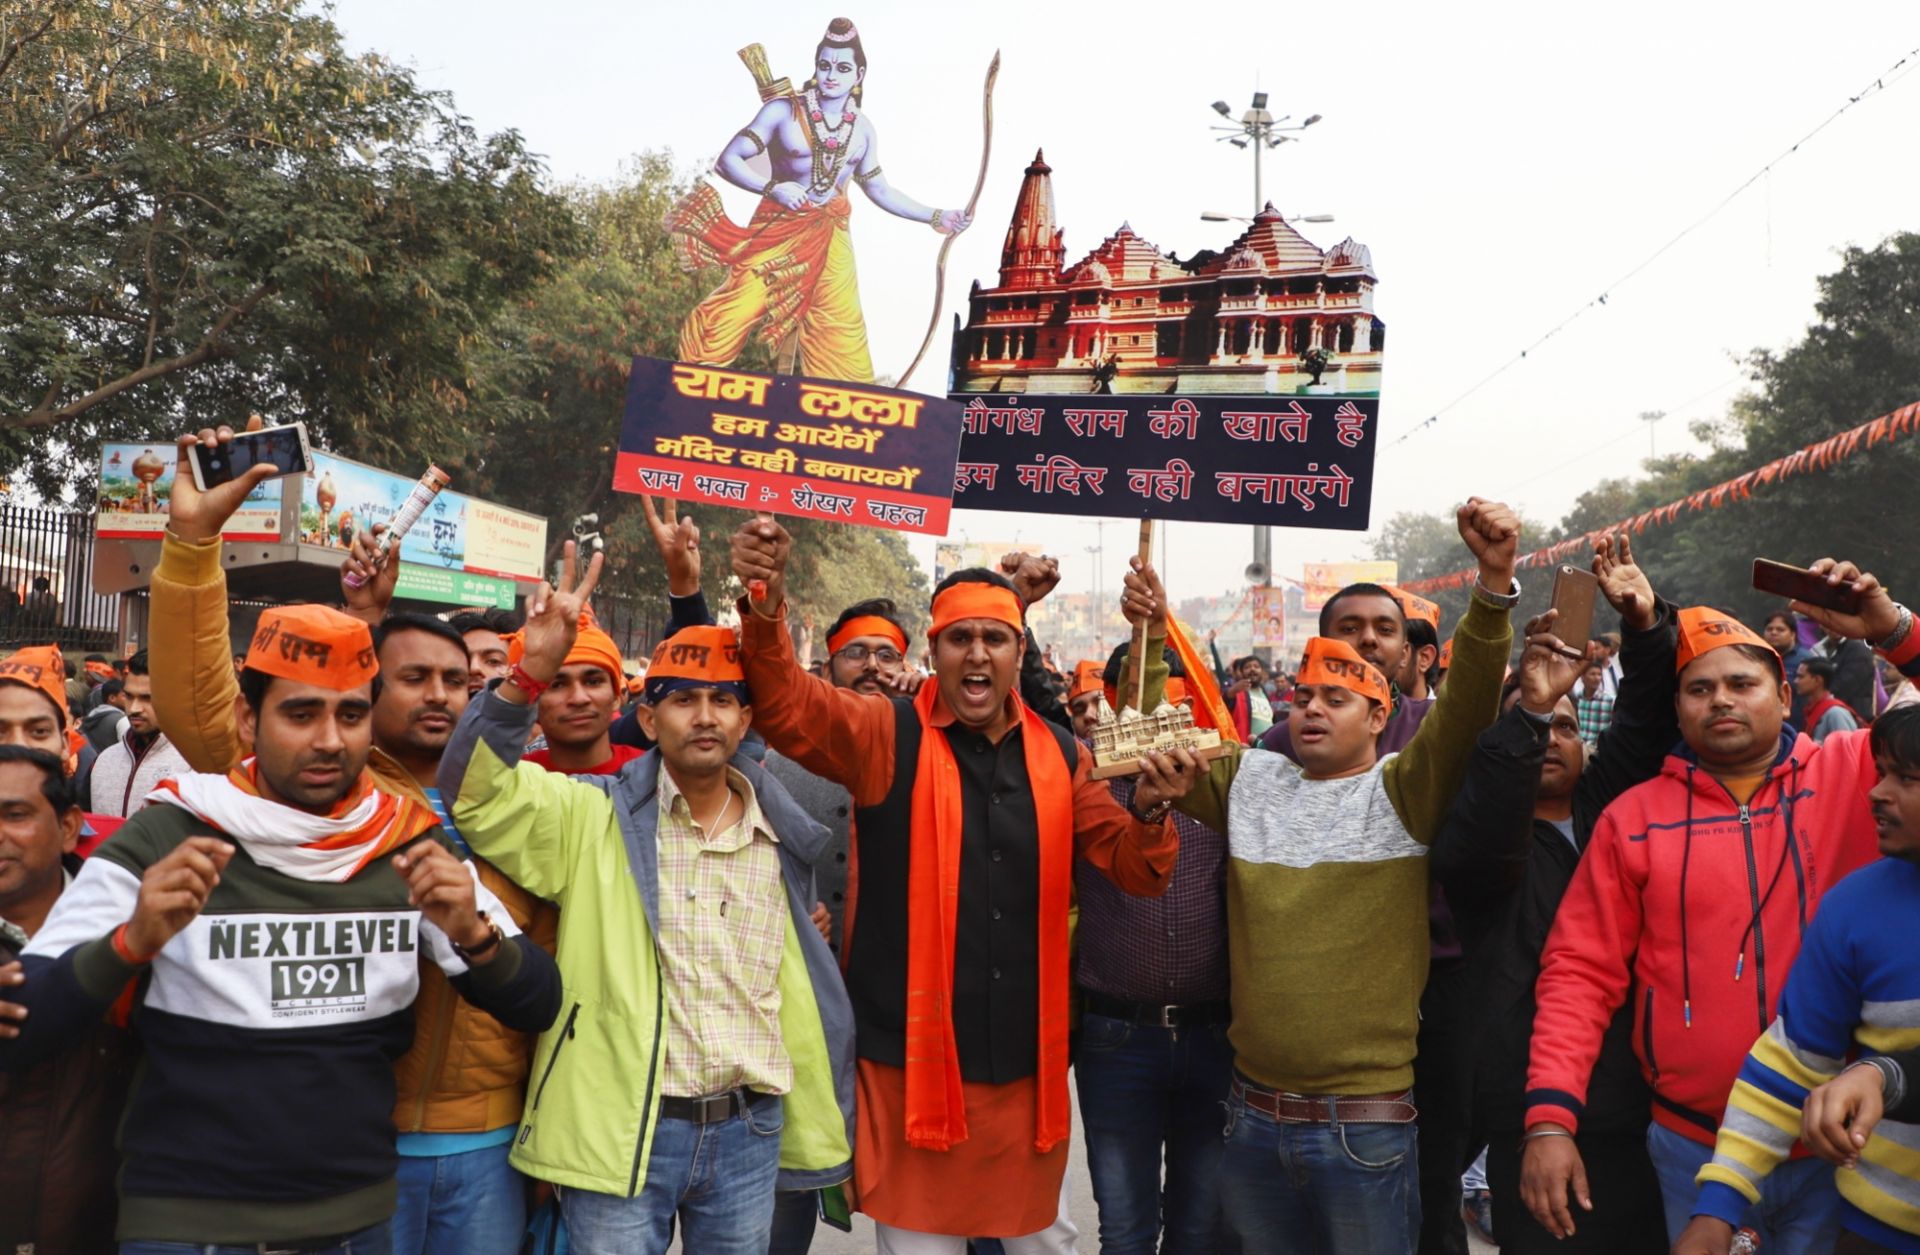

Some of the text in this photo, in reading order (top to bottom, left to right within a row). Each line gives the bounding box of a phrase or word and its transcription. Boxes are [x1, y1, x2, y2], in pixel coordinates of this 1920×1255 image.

[672, 364, 924, 428] राम लला
[712, 412, 769, 438] हम
[1063, 408, 1128, 438] राम
[1148, 401, 1200, 440] की
[1221, 400, 1312, 443] खाते
[1335, 401, 1368, 448] है
[740, 448, 798, 473] वही
[803, 457, 921, 490] बनायगें
[954, 454, 1354, 512] हम मंदिर वही बनाएंगे
[639, 467, 683, 492] राम
[694, 474, 749, 501] भक्त
[791, 482, 856, 516] शेखर
[866, 499, 928, 527] चहल
[279, 631, 332, 669] राम
[671, 644, 711, 668] राम
[1323, 656, 1366, 683] जय
[209, 919, 415, 960] NEXTLEVEL
[279, 962, 358, 996] 1991
[271, 1005, 366, 1018] CONFIDENT STYLEWEAR
